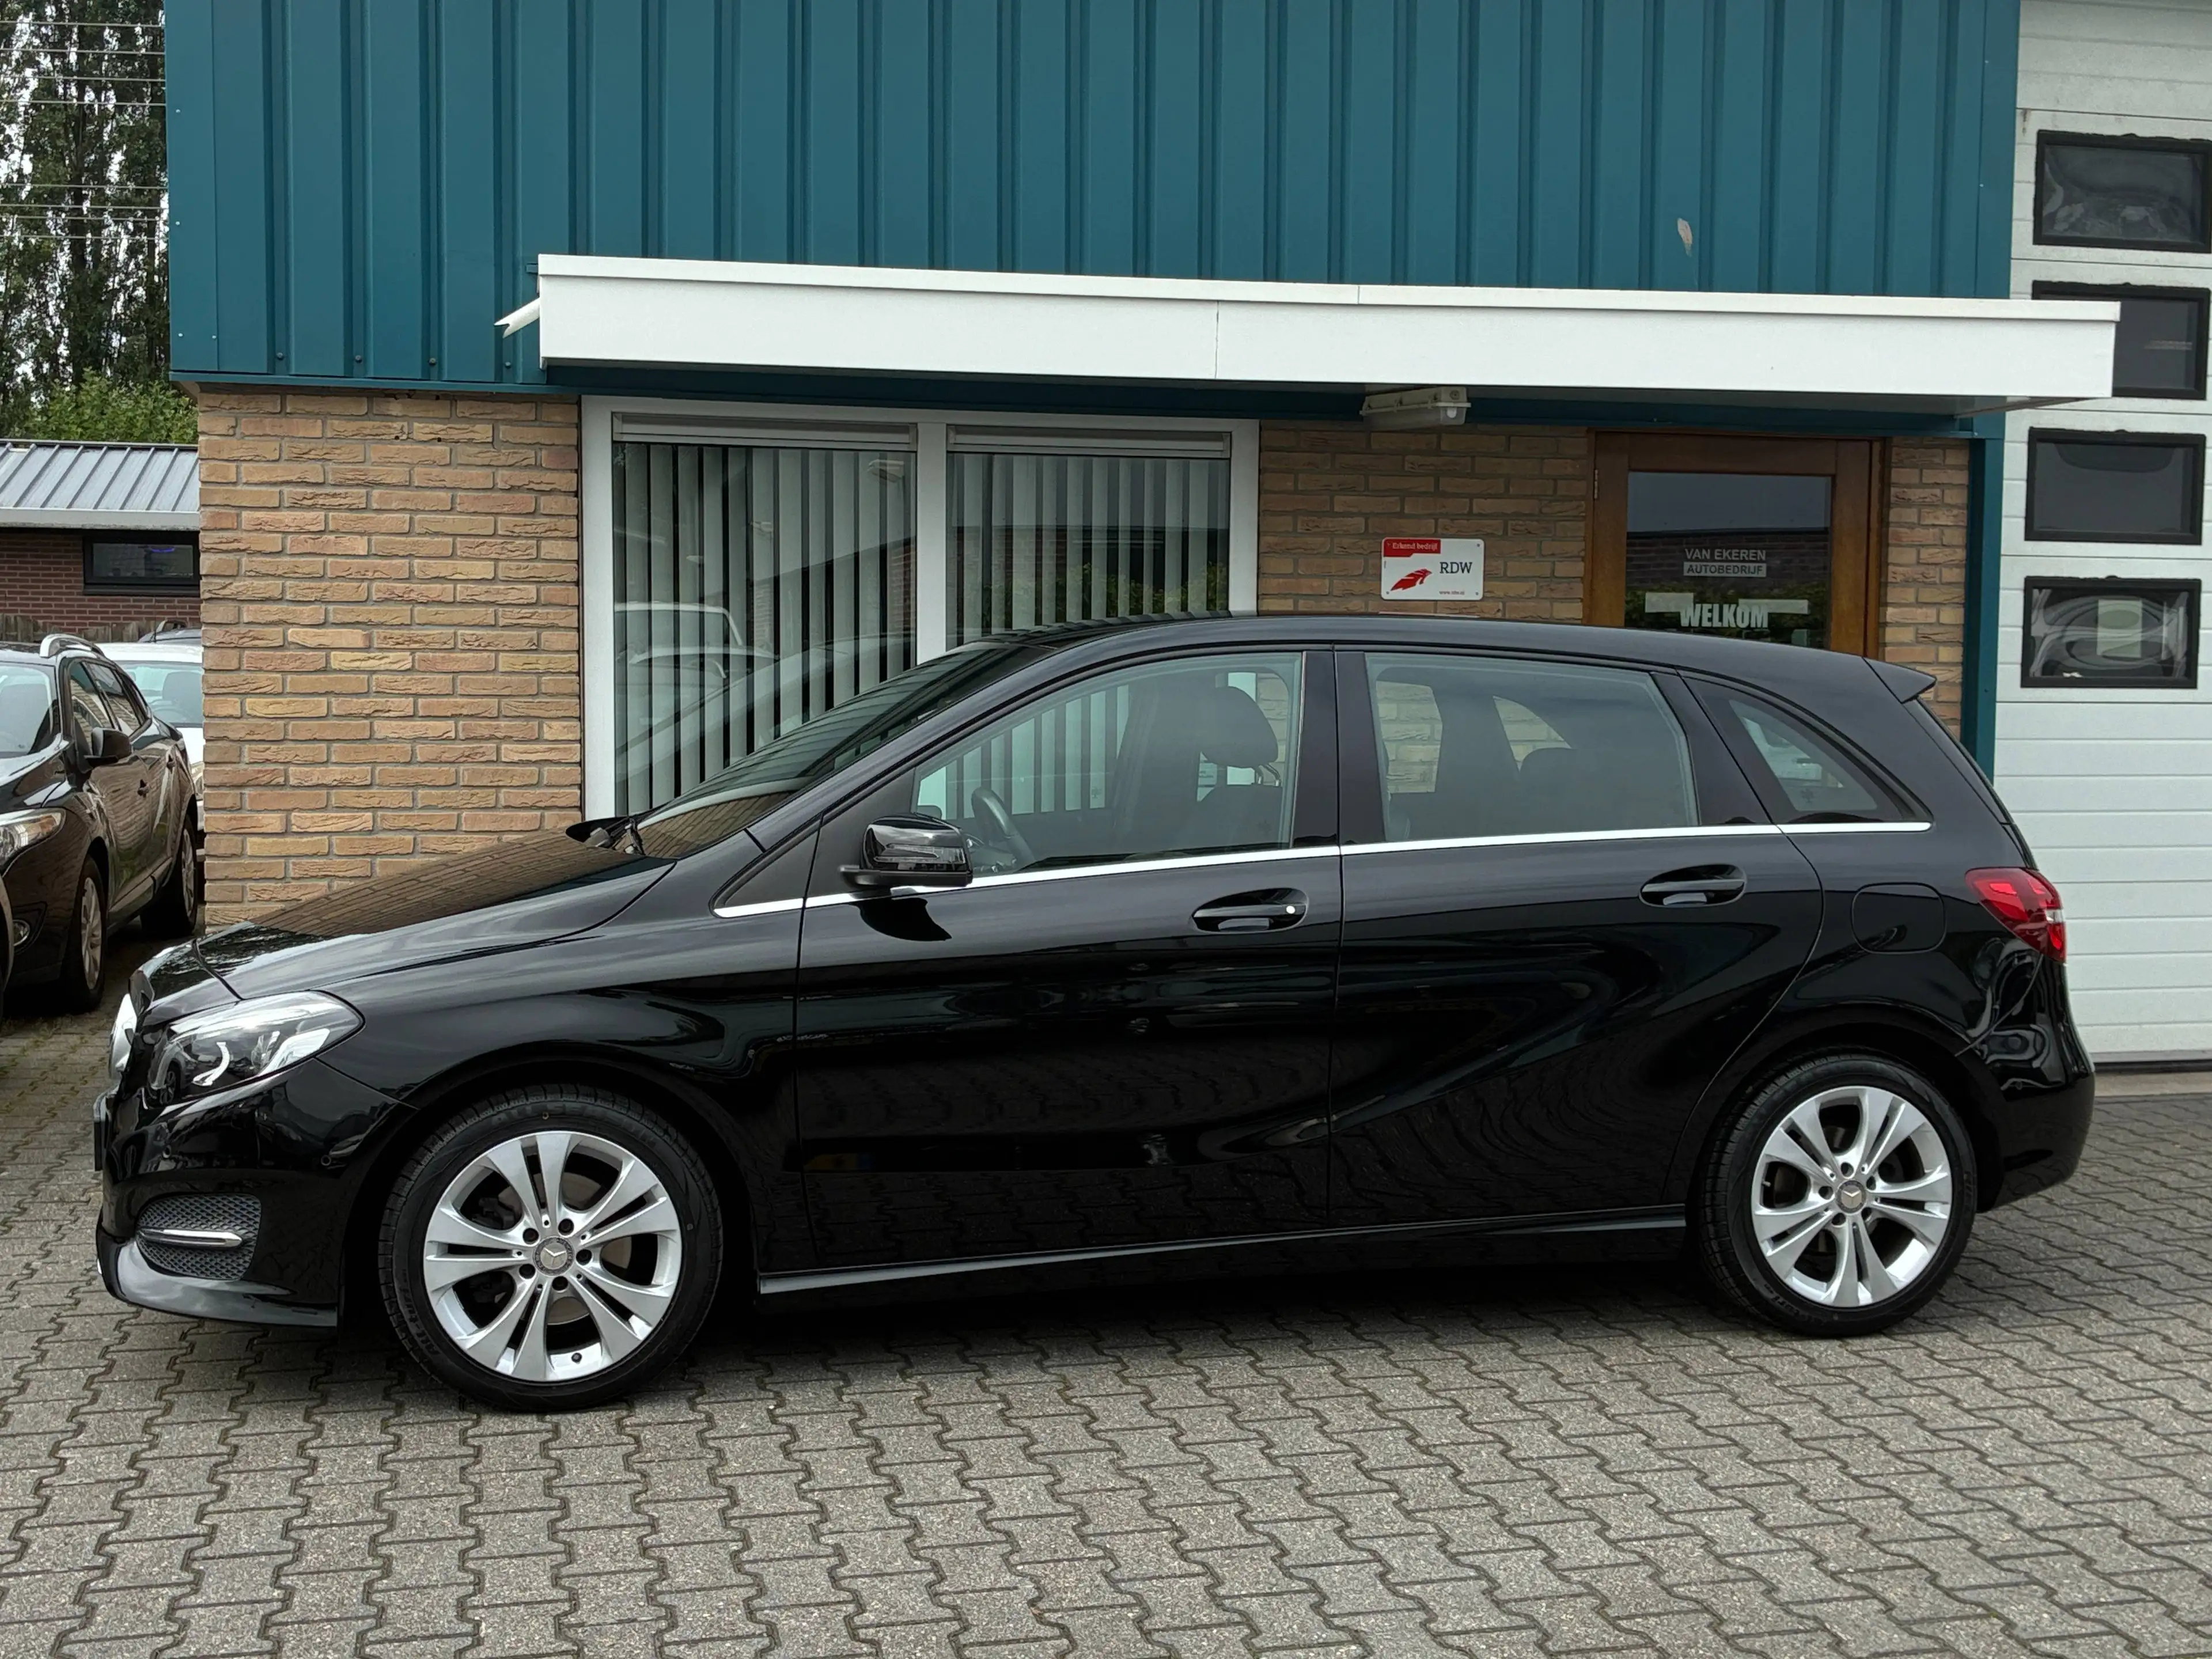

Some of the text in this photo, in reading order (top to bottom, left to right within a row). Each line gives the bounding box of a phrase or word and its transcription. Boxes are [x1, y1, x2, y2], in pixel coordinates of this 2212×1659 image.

[1684, 548, 1767, 560] VAN EKEREN
[1439, 561, 1473, 574] RDW
[1687, 564, 1763, 575] AUTOBEDRIJF
[1679, 603, 1769, 628] WELKOM
